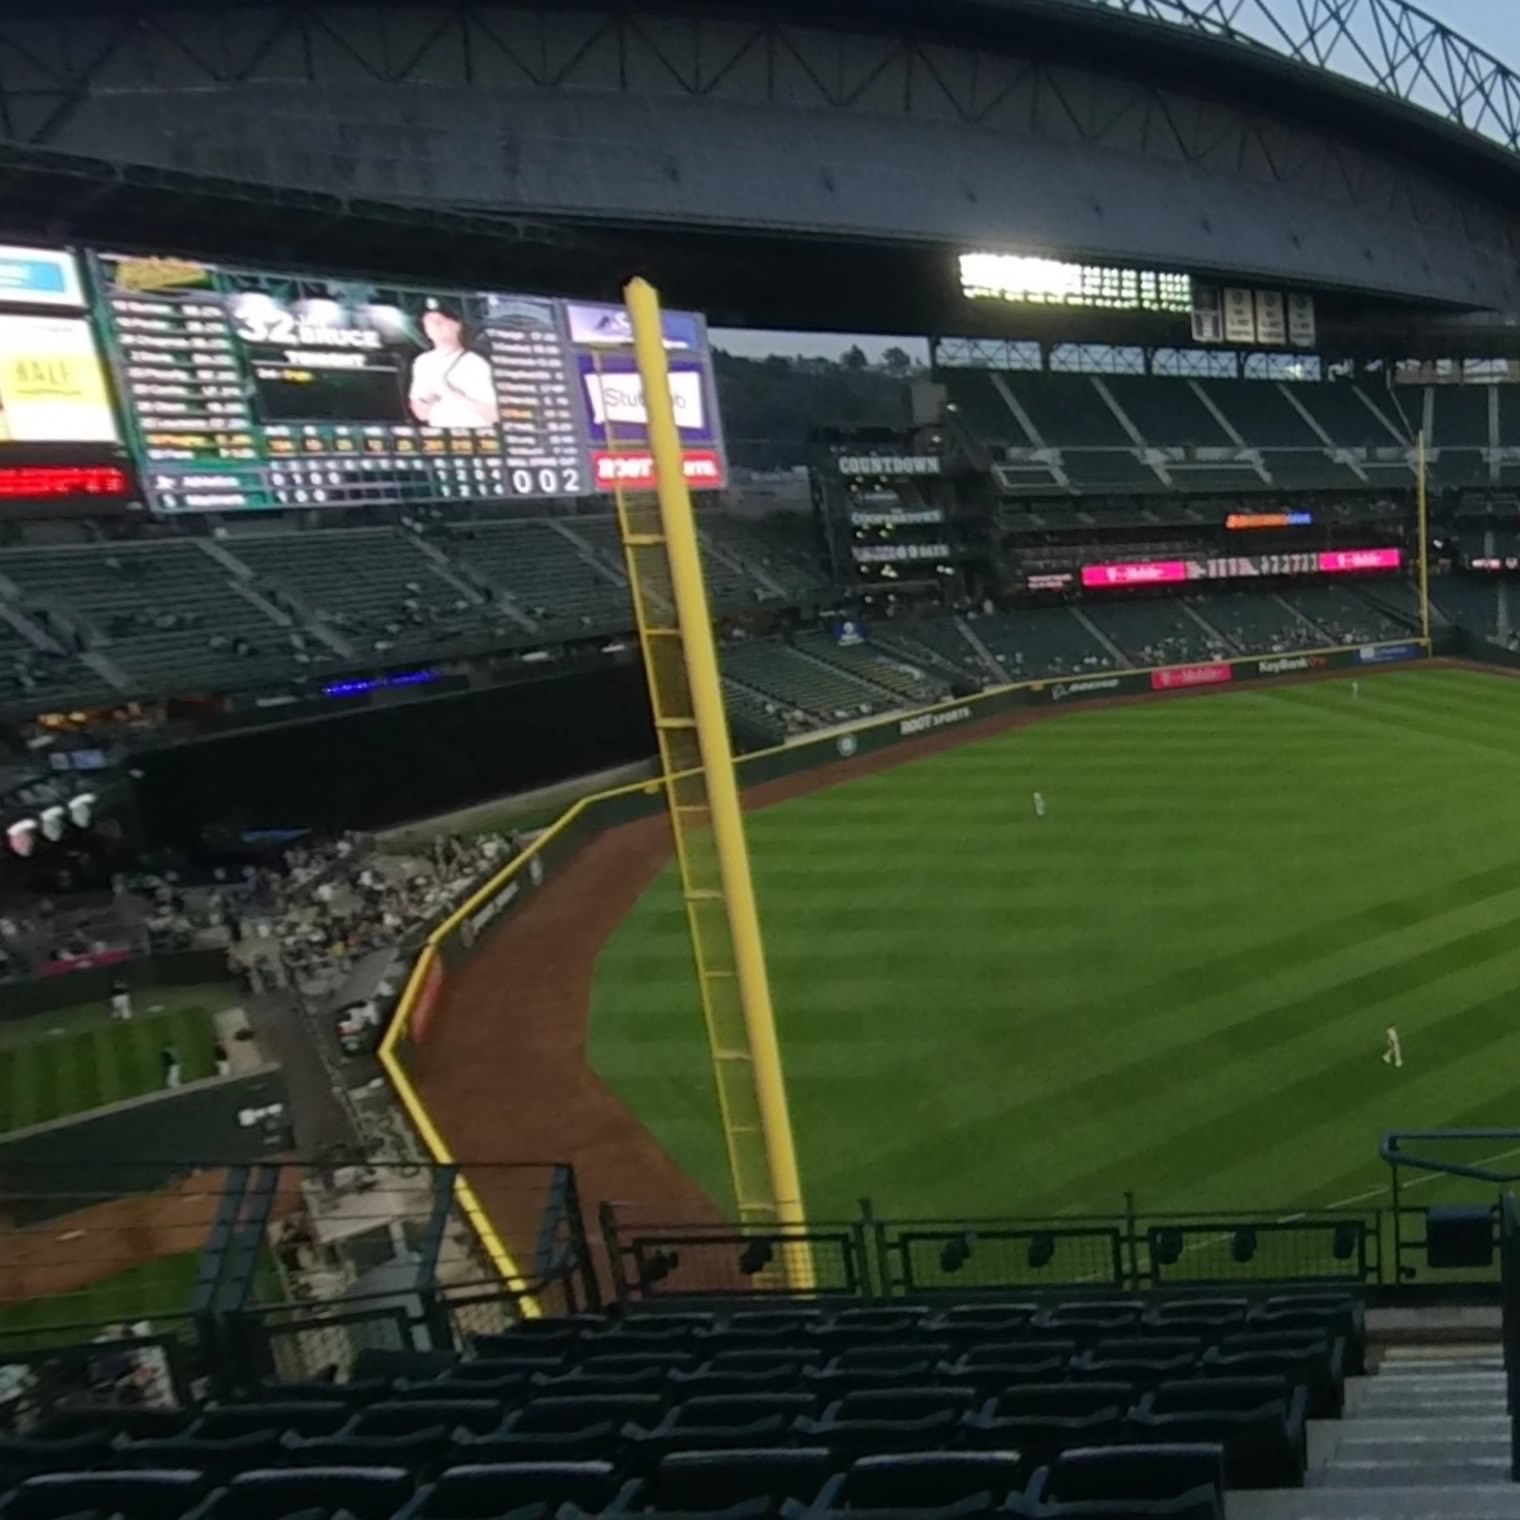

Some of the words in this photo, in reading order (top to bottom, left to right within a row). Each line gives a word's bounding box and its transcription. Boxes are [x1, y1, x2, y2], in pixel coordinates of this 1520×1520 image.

[234, 303, 299, 345] 32
[299, 327, 382, 349] BRUCE
[838, 456, 940, 475] COUNTDOWN
[513, 469, 532, 493] 0
[539, 468, 557, 493] 0
[562, 468, 580, 492] 2
[1259, 657, 1308, 673] KeyBank
